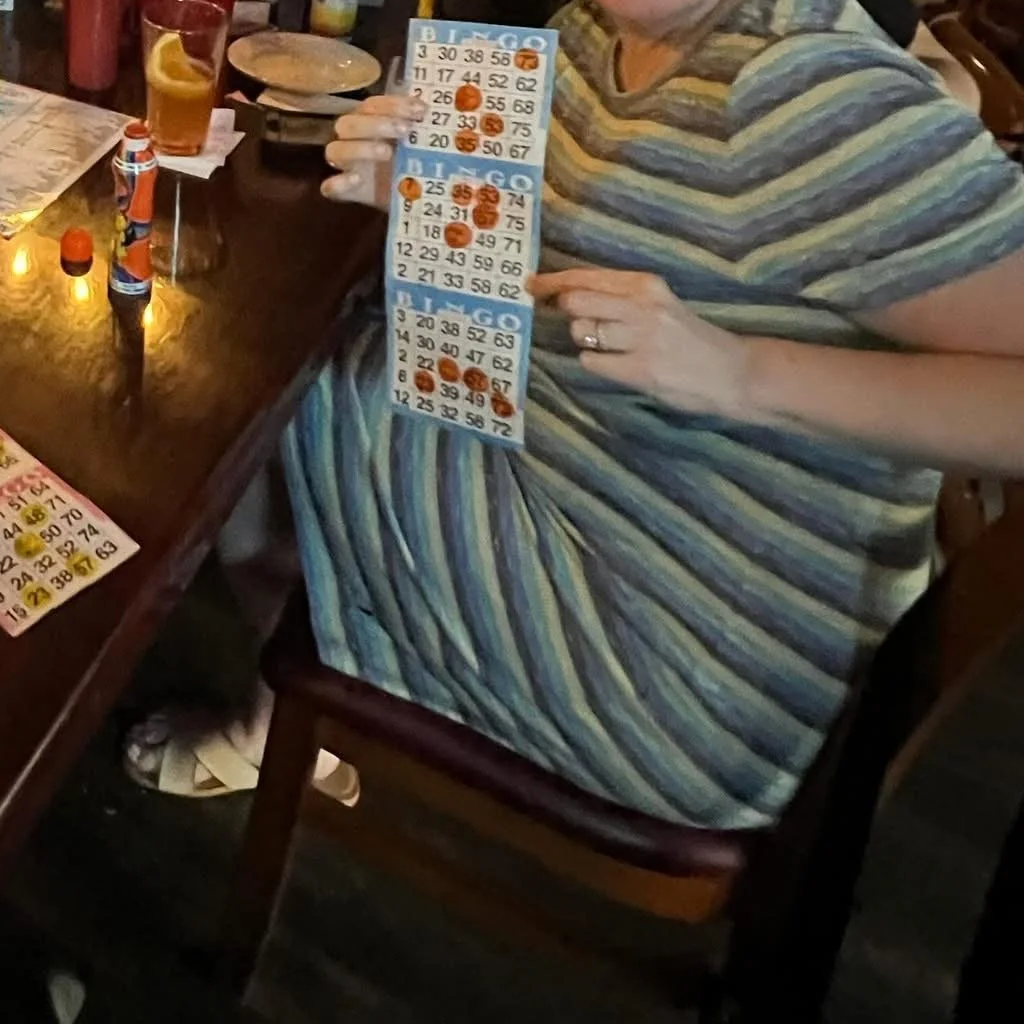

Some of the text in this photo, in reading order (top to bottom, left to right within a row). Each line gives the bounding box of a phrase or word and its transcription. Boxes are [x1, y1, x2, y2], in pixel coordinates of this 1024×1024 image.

[417, 45, 427, 59] 3
[438, 47, 457, 61] 30
[464, 49, 484, 63] 38
[414, 67, 537, 92] 11 17 44 52 62
[433, 90, 453, 104] 26
[485, 96, 506, 111] 55
[431, 112, 451, 126] 27
[457, 115, 476, 129] 33
[511, 121, 532, 138] 75
[408, 131, 418, 145] 6
[429, 134, 449, 148] 20
[483, 141, 502, 156] 50
[509, 145, 531, 159] 67
[426, 181, 445, 196] 25
[507, 193, 526, 209] 74
[423, 202, 443, 217] 24
[450, 207, 468, 221] 31
[506, 214, 525, 231] 75
[403, 220, 522, 254] 1 18 49 71
[396, 242, 523, 276] 12 29 43 59 66
[397, 264, 520, 299] 2 21 33 58 62
[397, 309, 515, 350] 3 20 38 52 63
[395, 329, 513, 373] 14 30 40 47 62
[398, 349, 407, 363] 2
[417, 356, 434, 371] 22
[492, 378, 511, 393] 67
[440, 383, 459, 400] 39
[465, 392, 485, 408] 49
[394, 390, 410, 404] 12
[417, 396, 434, 412] 25
[440, 404, 458, 421] 32
[491, 418, 512, 437] 72
[8, 496, 28, 511] 51
[30, 482, 50, 497] 64
[2, 523, 24, 541] 44
[45, 495, 66, 510] 71
[39, 524, 62, 543] 50
[60, 508, 83, 526] 70
[11, 571, 34, 591] 24
[34, 555, 57, 574] 32
[56, 540, 77, 557] 52
[77, 523, 100, 543] 74
[50, 569, 74, 590] 38
[96, 540, 118, 560] 63
